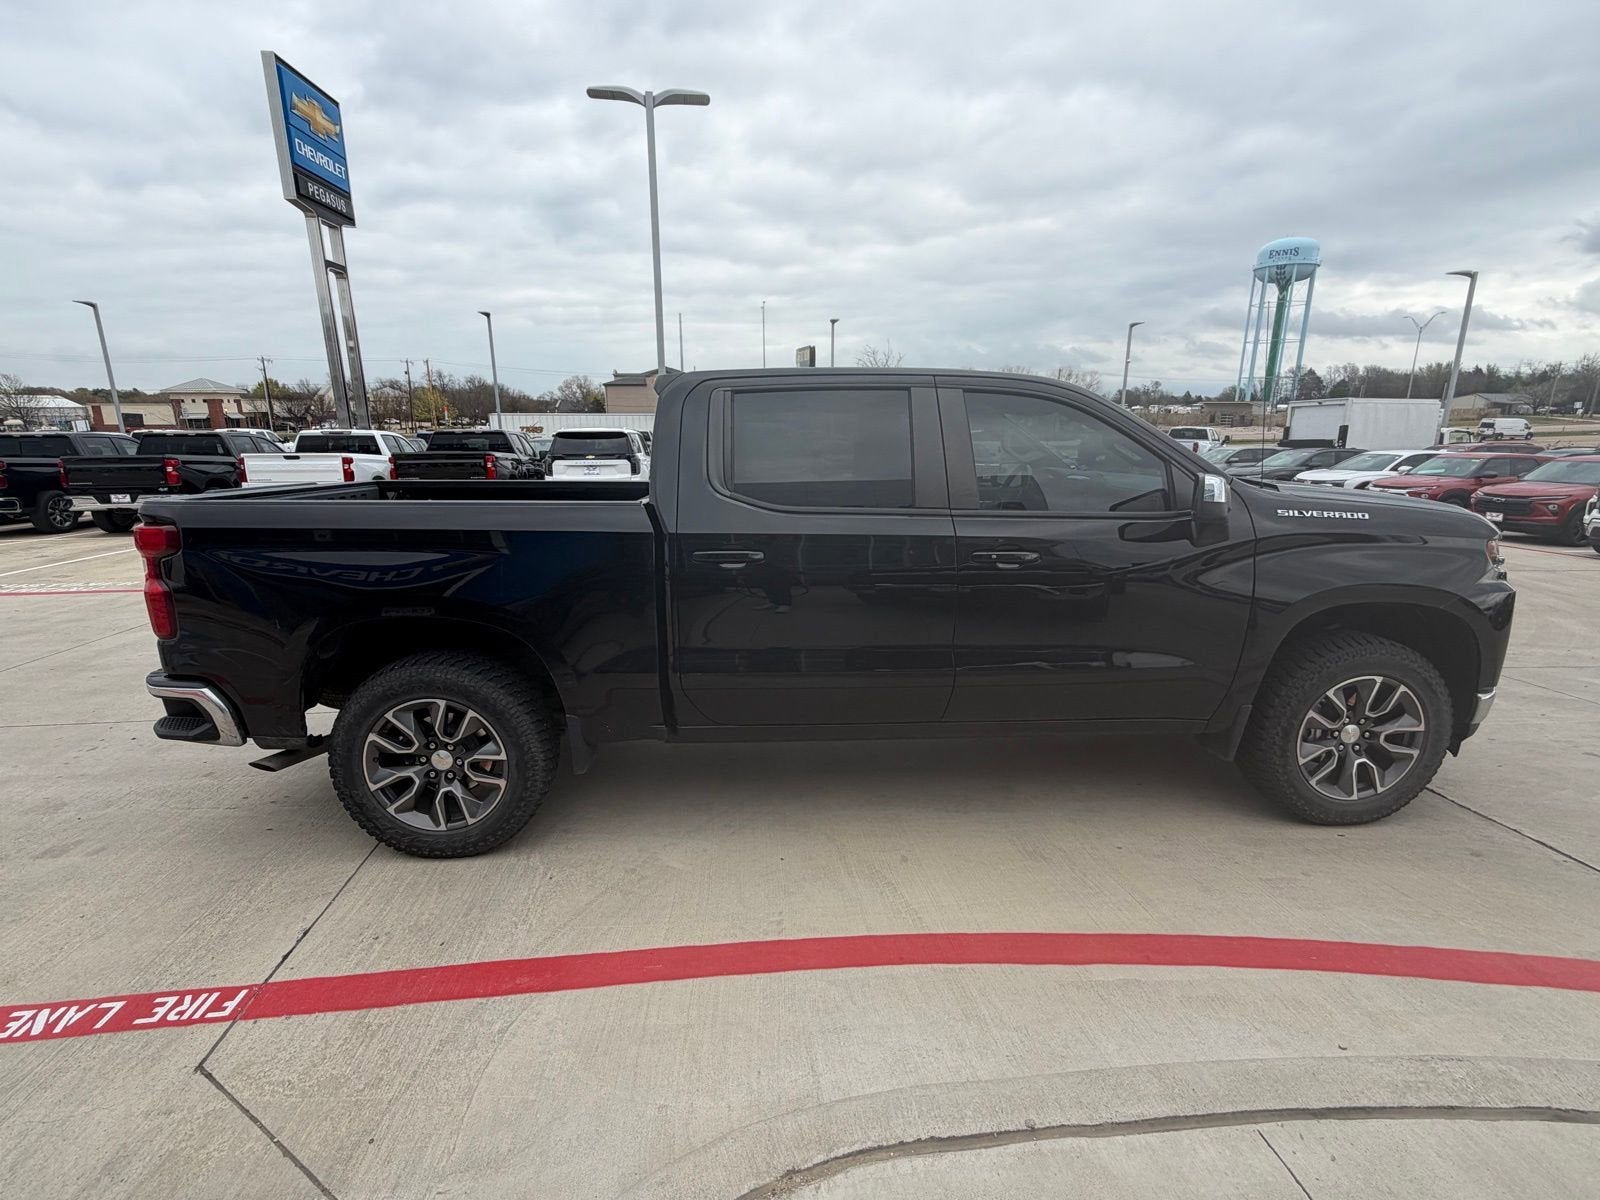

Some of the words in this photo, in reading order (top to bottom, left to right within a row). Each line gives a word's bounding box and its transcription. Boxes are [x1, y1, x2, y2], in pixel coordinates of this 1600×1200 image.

[295, 138, 345, 179] CHEVROLET
[307, 182, 347, 213] PEGASUS
[1268, 247, 1299, 259] ENNIS
[1276, 509, 1370, 520] SILVERADO
[0, 1001, 127, 1038] LANE
[132, 989, 249, 1025] FIRE
